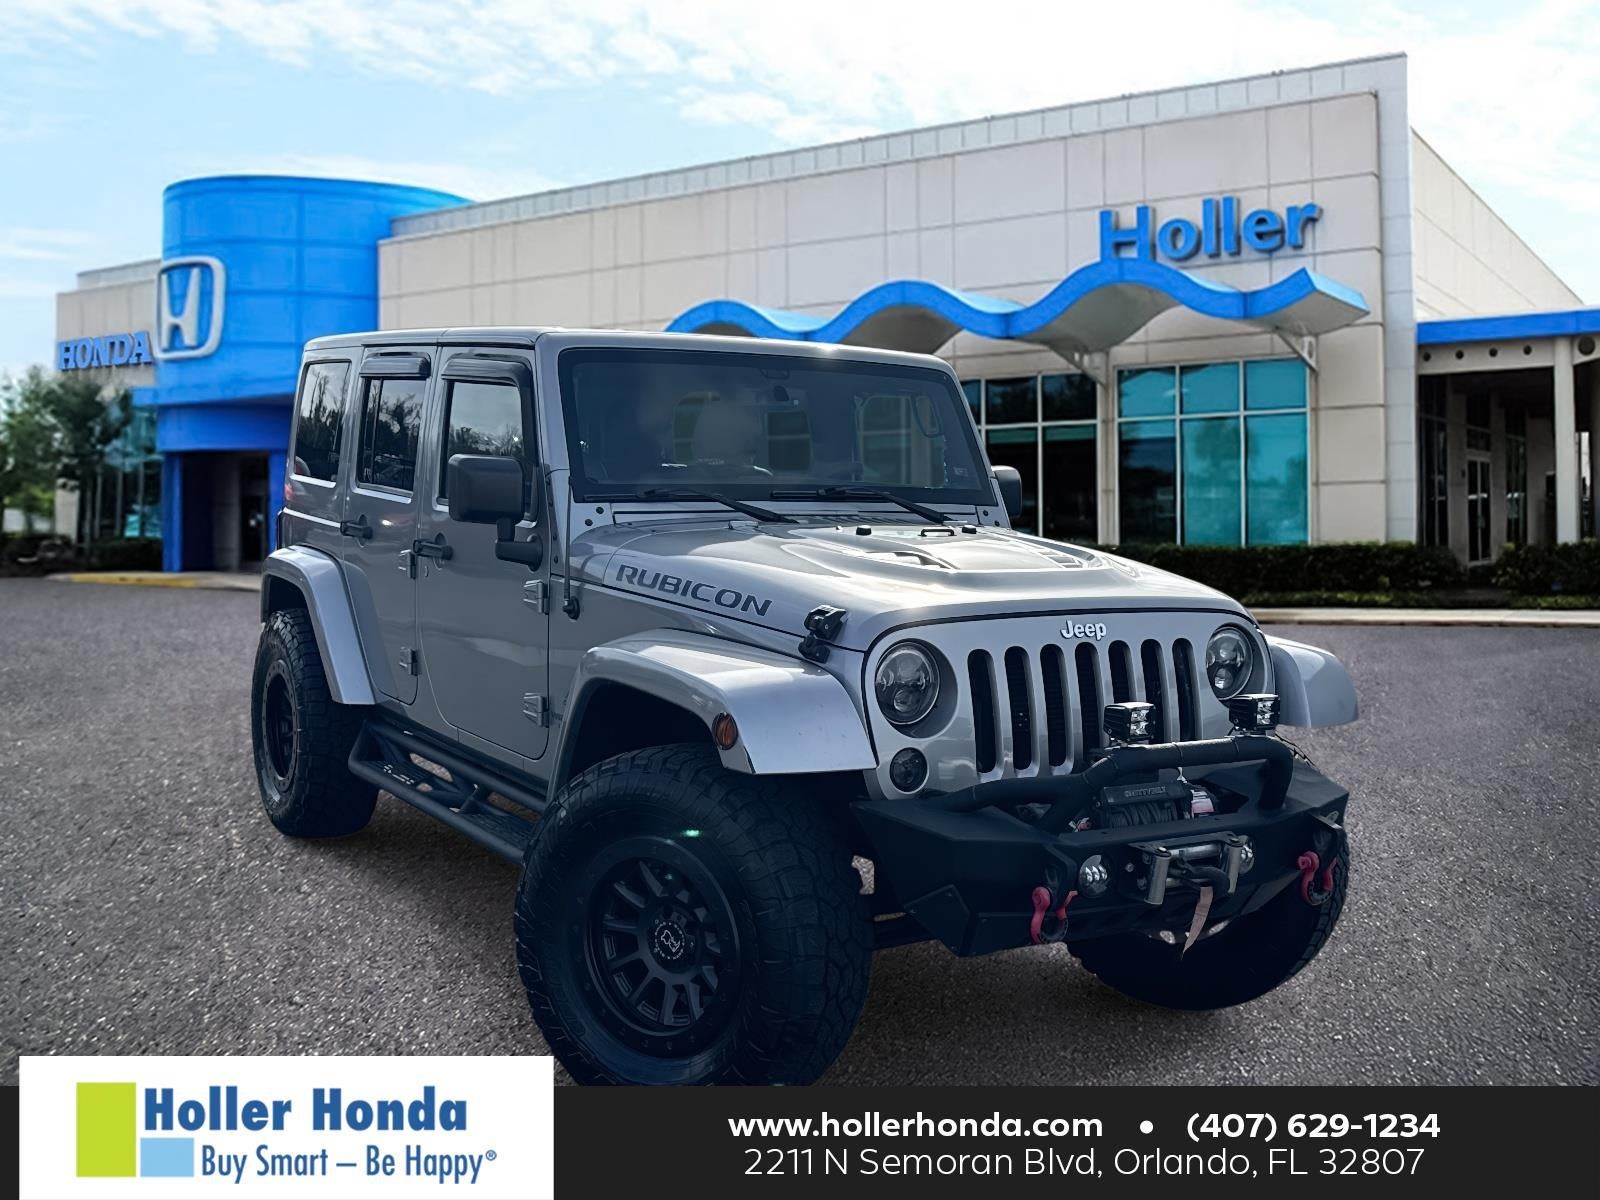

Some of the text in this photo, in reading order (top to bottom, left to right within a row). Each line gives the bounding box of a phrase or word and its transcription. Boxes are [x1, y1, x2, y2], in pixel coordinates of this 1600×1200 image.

[1099, 196, 1322, 261] Holler
[57, 331, 152, 371] HONDA
[615, 564, 773, 617] RUBICON
[1060, 619, 1107, 641] Jeep
